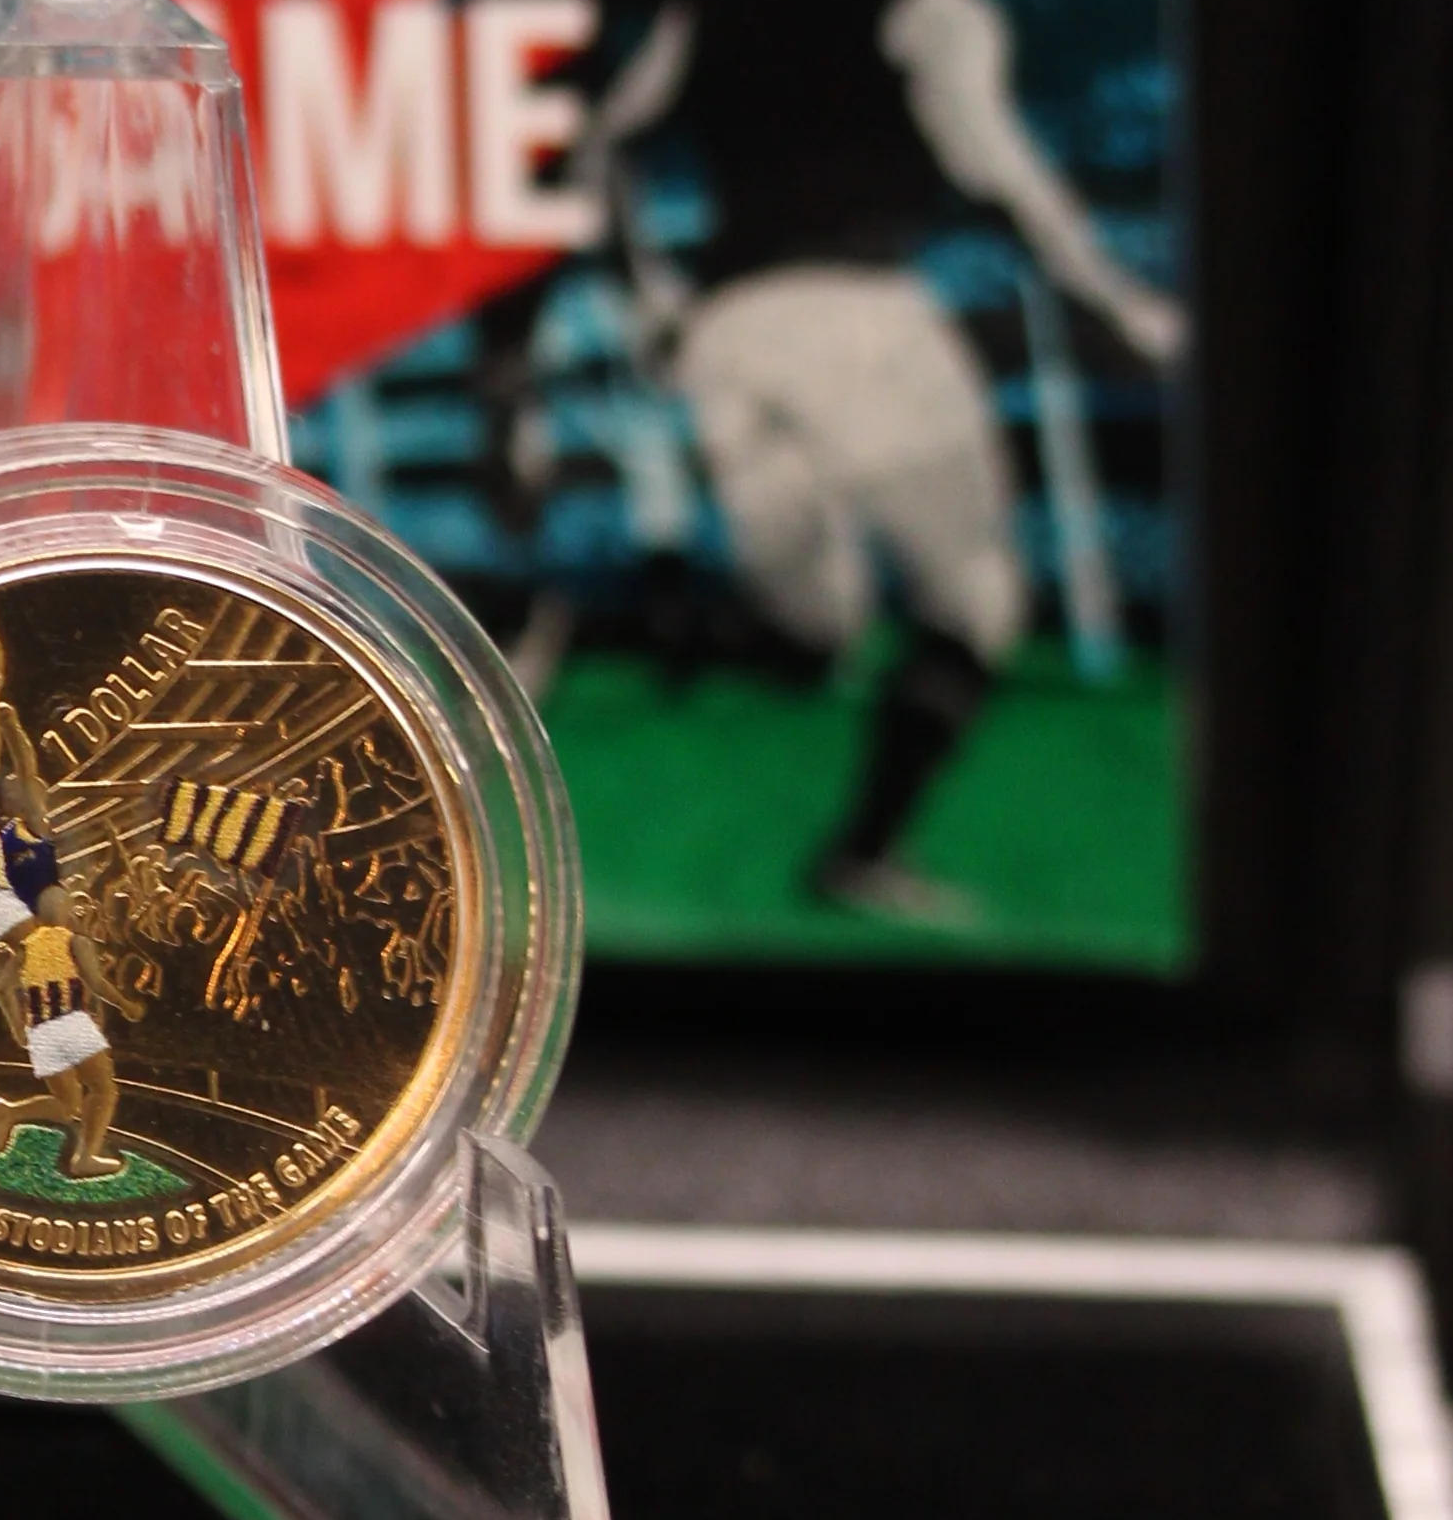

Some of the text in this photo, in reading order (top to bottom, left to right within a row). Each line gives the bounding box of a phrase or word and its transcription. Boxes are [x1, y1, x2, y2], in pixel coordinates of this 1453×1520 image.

[40, 607, 208, 766] 1 DOLLAR
[164, 1202, 209, 1246] OF
[208, 1171, 283, 1229] THE
[274, 1104, 362, 1188] GAME
